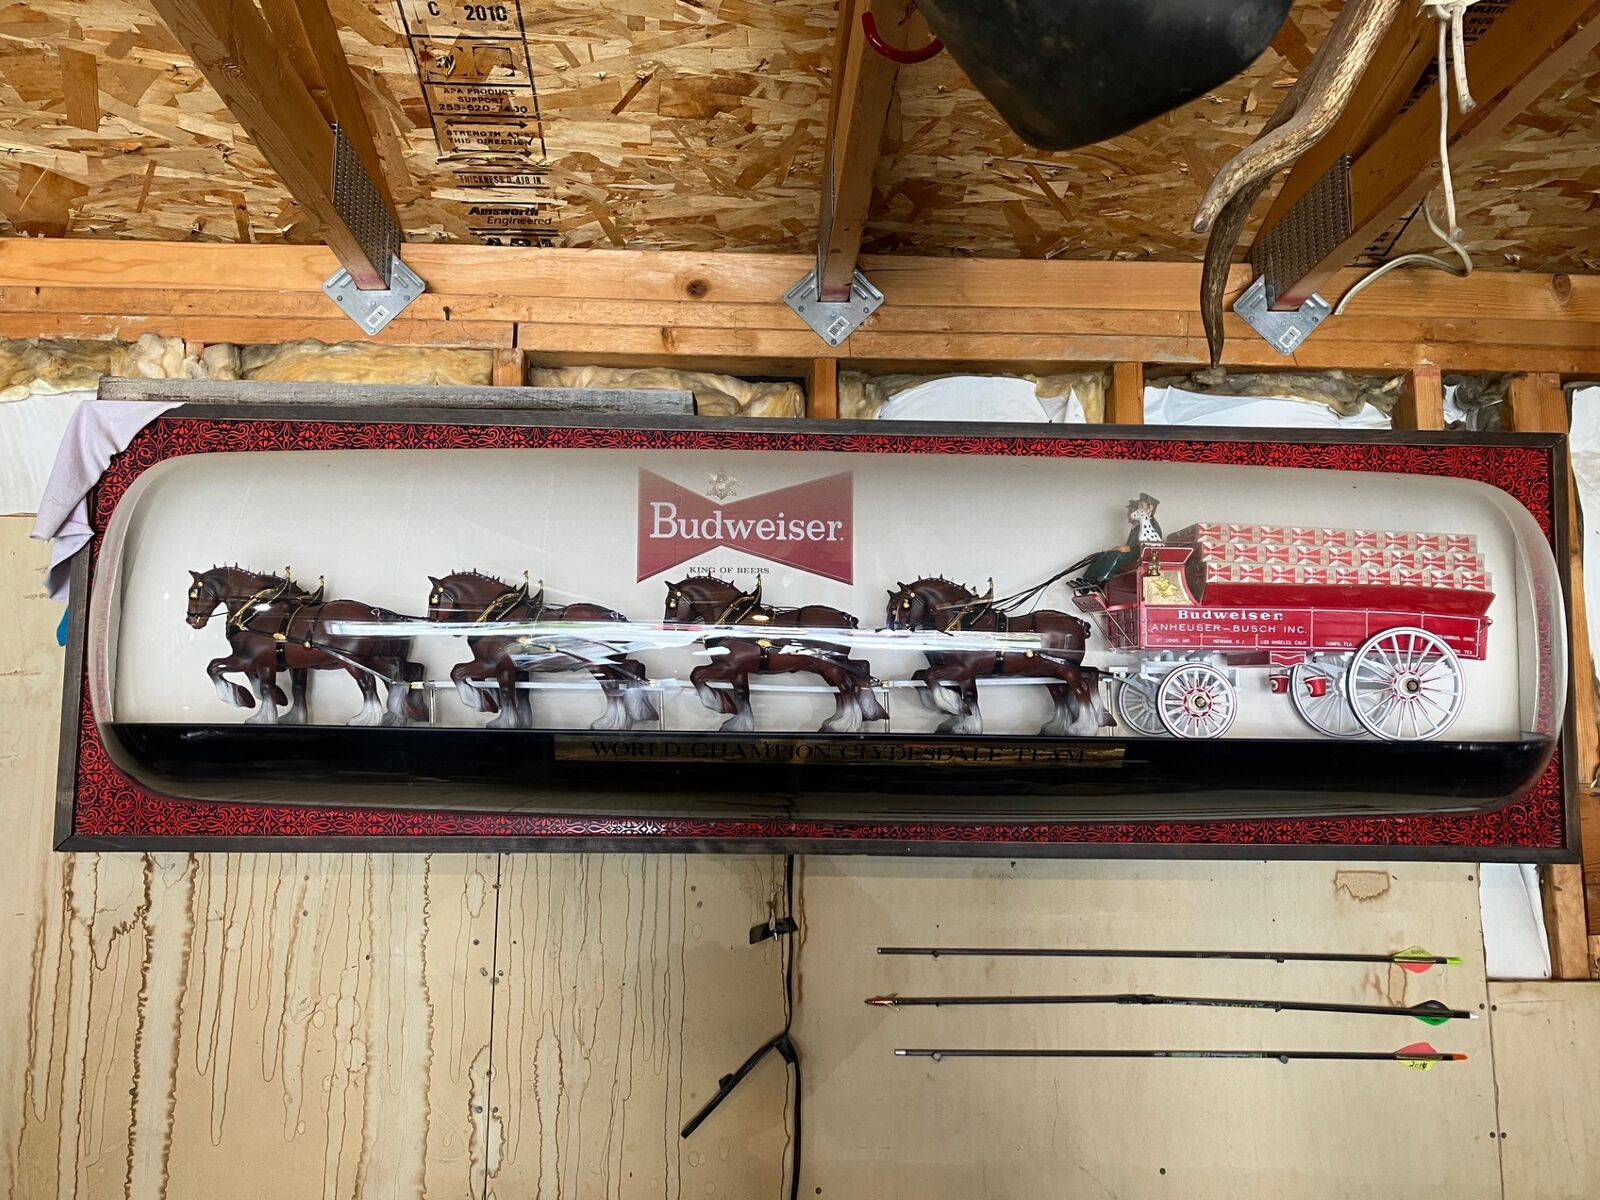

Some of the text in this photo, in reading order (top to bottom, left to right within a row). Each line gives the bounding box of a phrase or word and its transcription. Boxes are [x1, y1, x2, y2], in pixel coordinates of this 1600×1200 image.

[467, 88, 516, 97] PRODUCT
[457, 96, 505, 104] SUPPORT
[445, 130, 501, 138] STRENGTH
[477, 138, 533, 147] DIRECTION
[459, 174, 505, 184] THICKNESS
[486, 216, 553, 227] Engineered
[689, 566, 716, 574] KING
[1283, 625, 1308, 634] INC.
[591, 741, 1086, 762] WORLD CHAMPION CLYDESDALE TEAM
